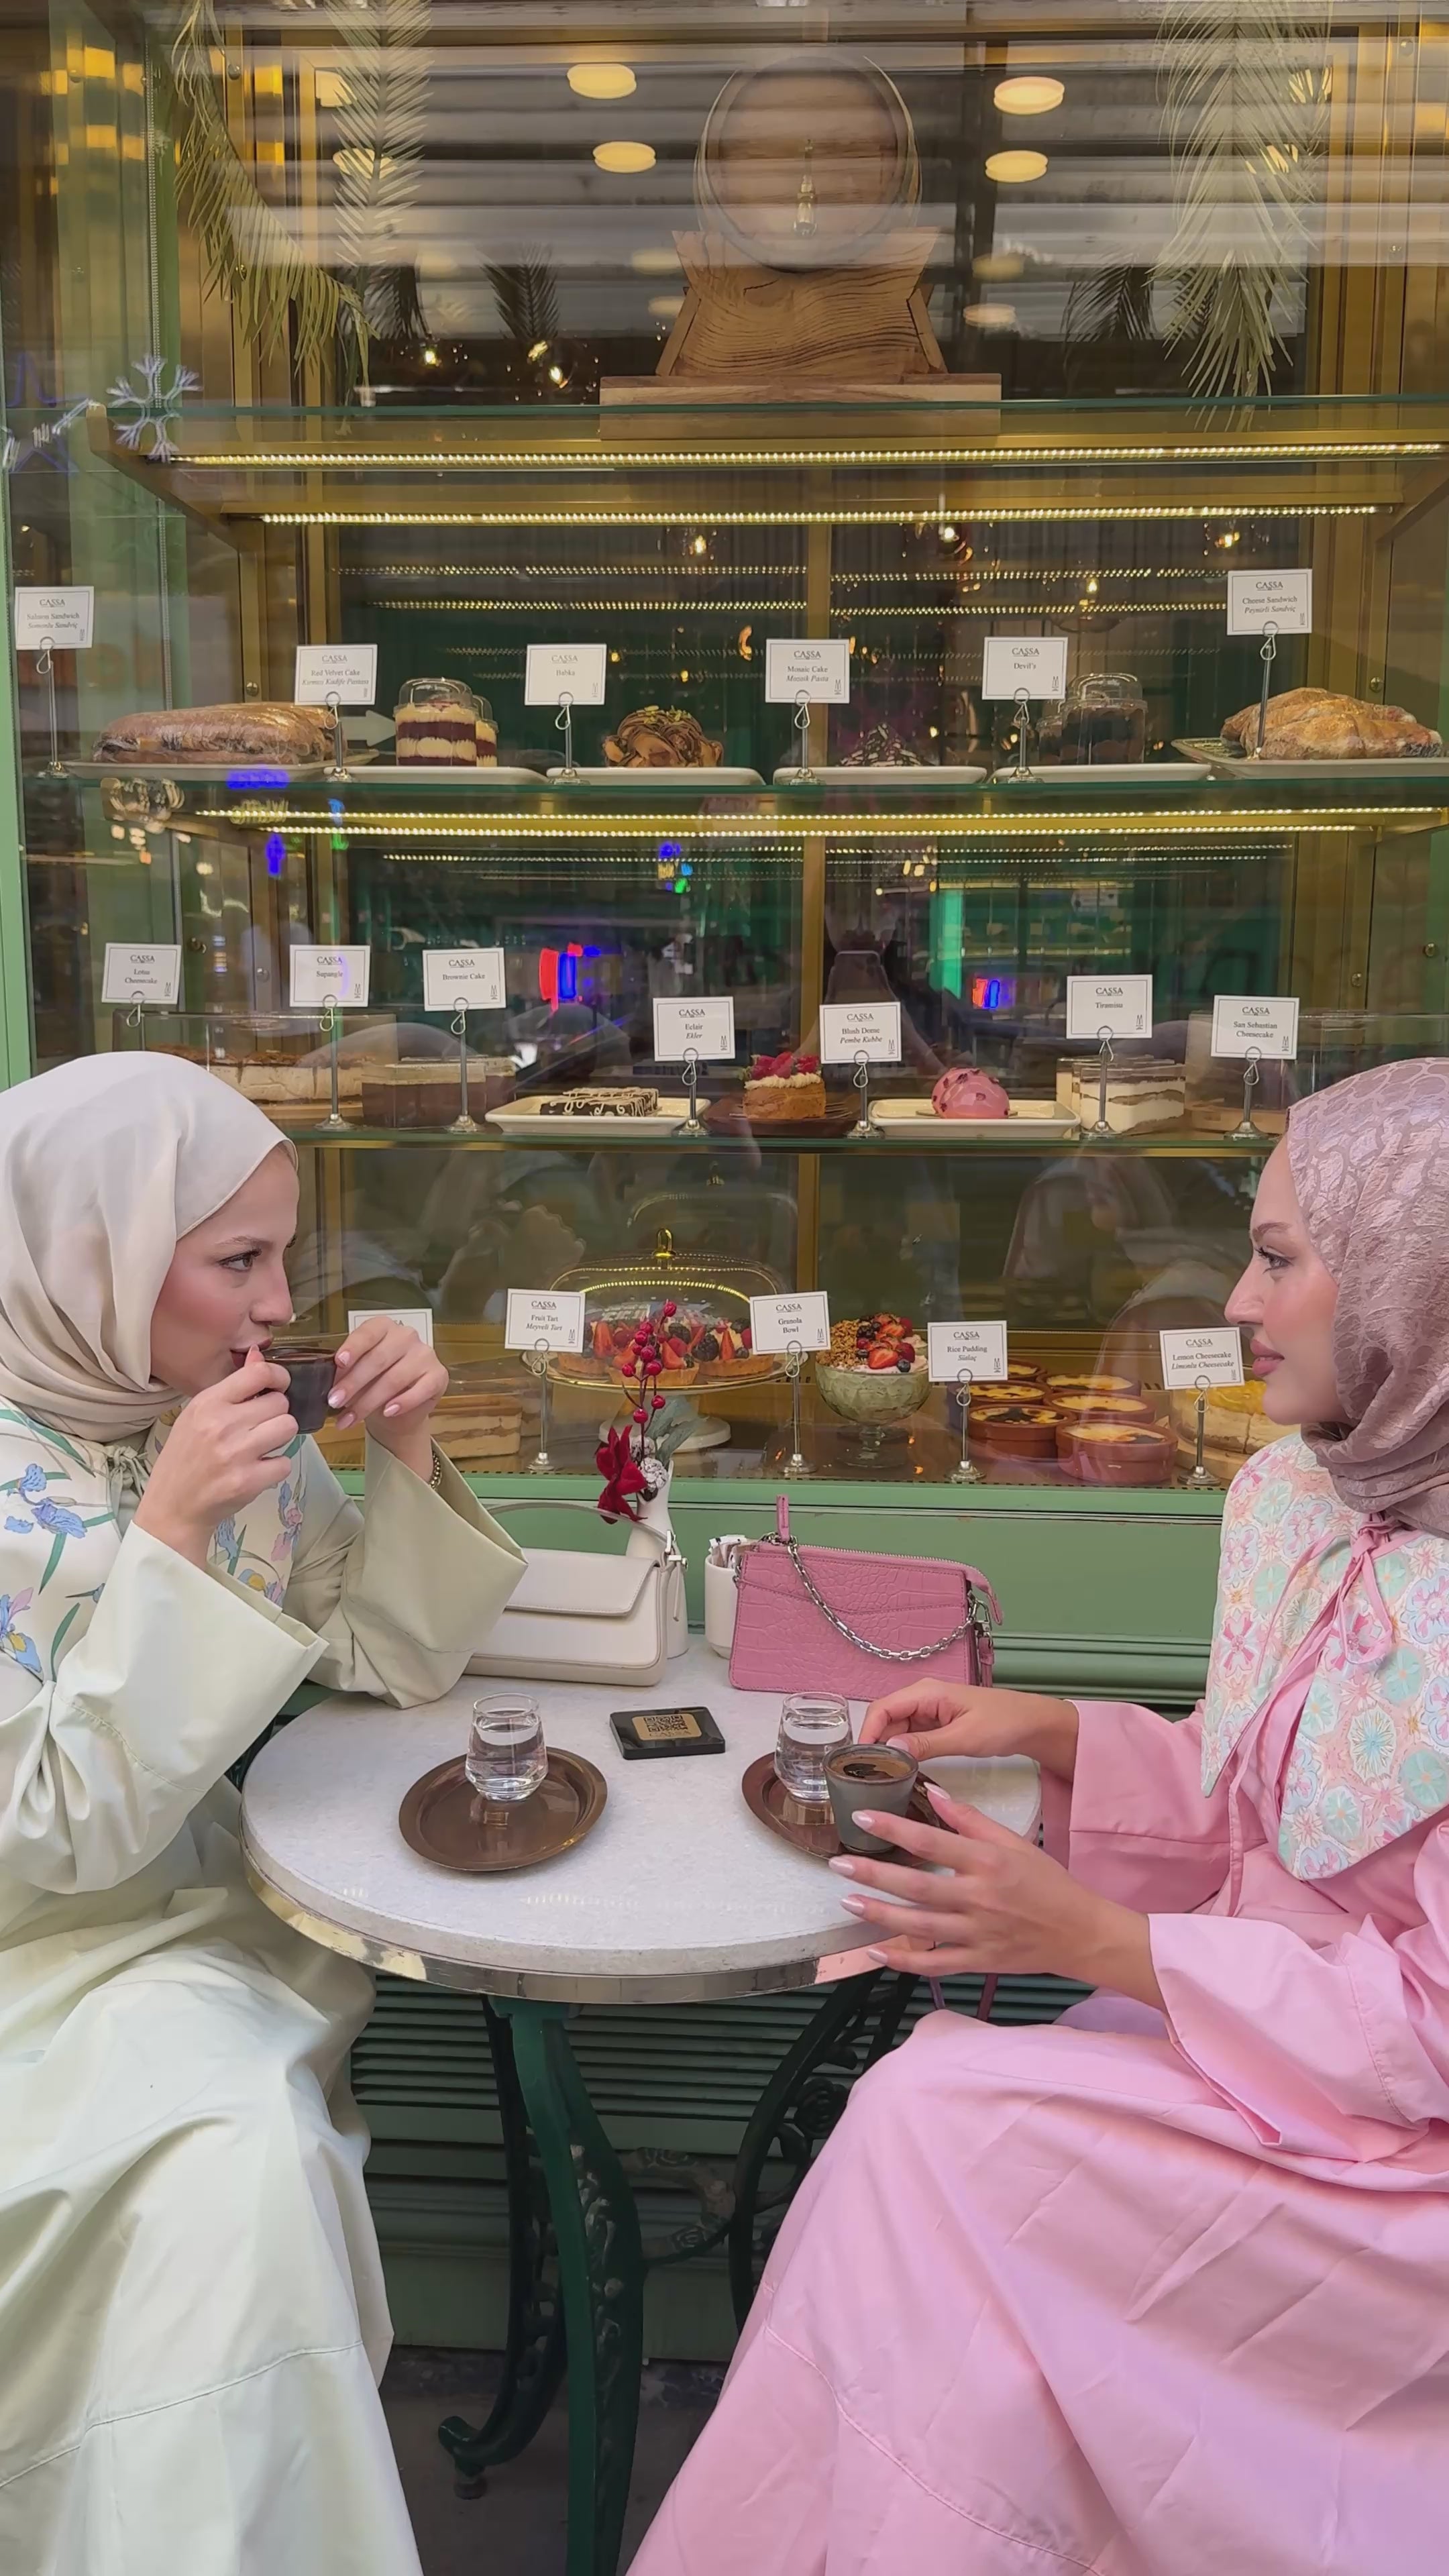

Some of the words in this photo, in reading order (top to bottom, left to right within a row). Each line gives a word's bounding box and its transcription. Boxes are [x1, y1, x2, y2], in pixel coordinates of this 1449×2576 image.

[1256, 582, 1283, 590] CASSA
[40, 599, 65, 607] CASSA
[794, 651, 821, 659] CASSA
[1012, 648, 1039, 656] CASSA
[322, 655, 347, 663] CASSA
[449, 959, 474, 967] CASSA
[679, 1009, 705, 1017] CASSA
[1242, 1007, 1270, 1015] CASSA
[531, 1301, 556, 1309] CASSA
[776, 1304, 802, 1312] CASSA
[526, 1323, 550, 1332] Meyveli
[953, 1332, 979, 1340] CASSA
